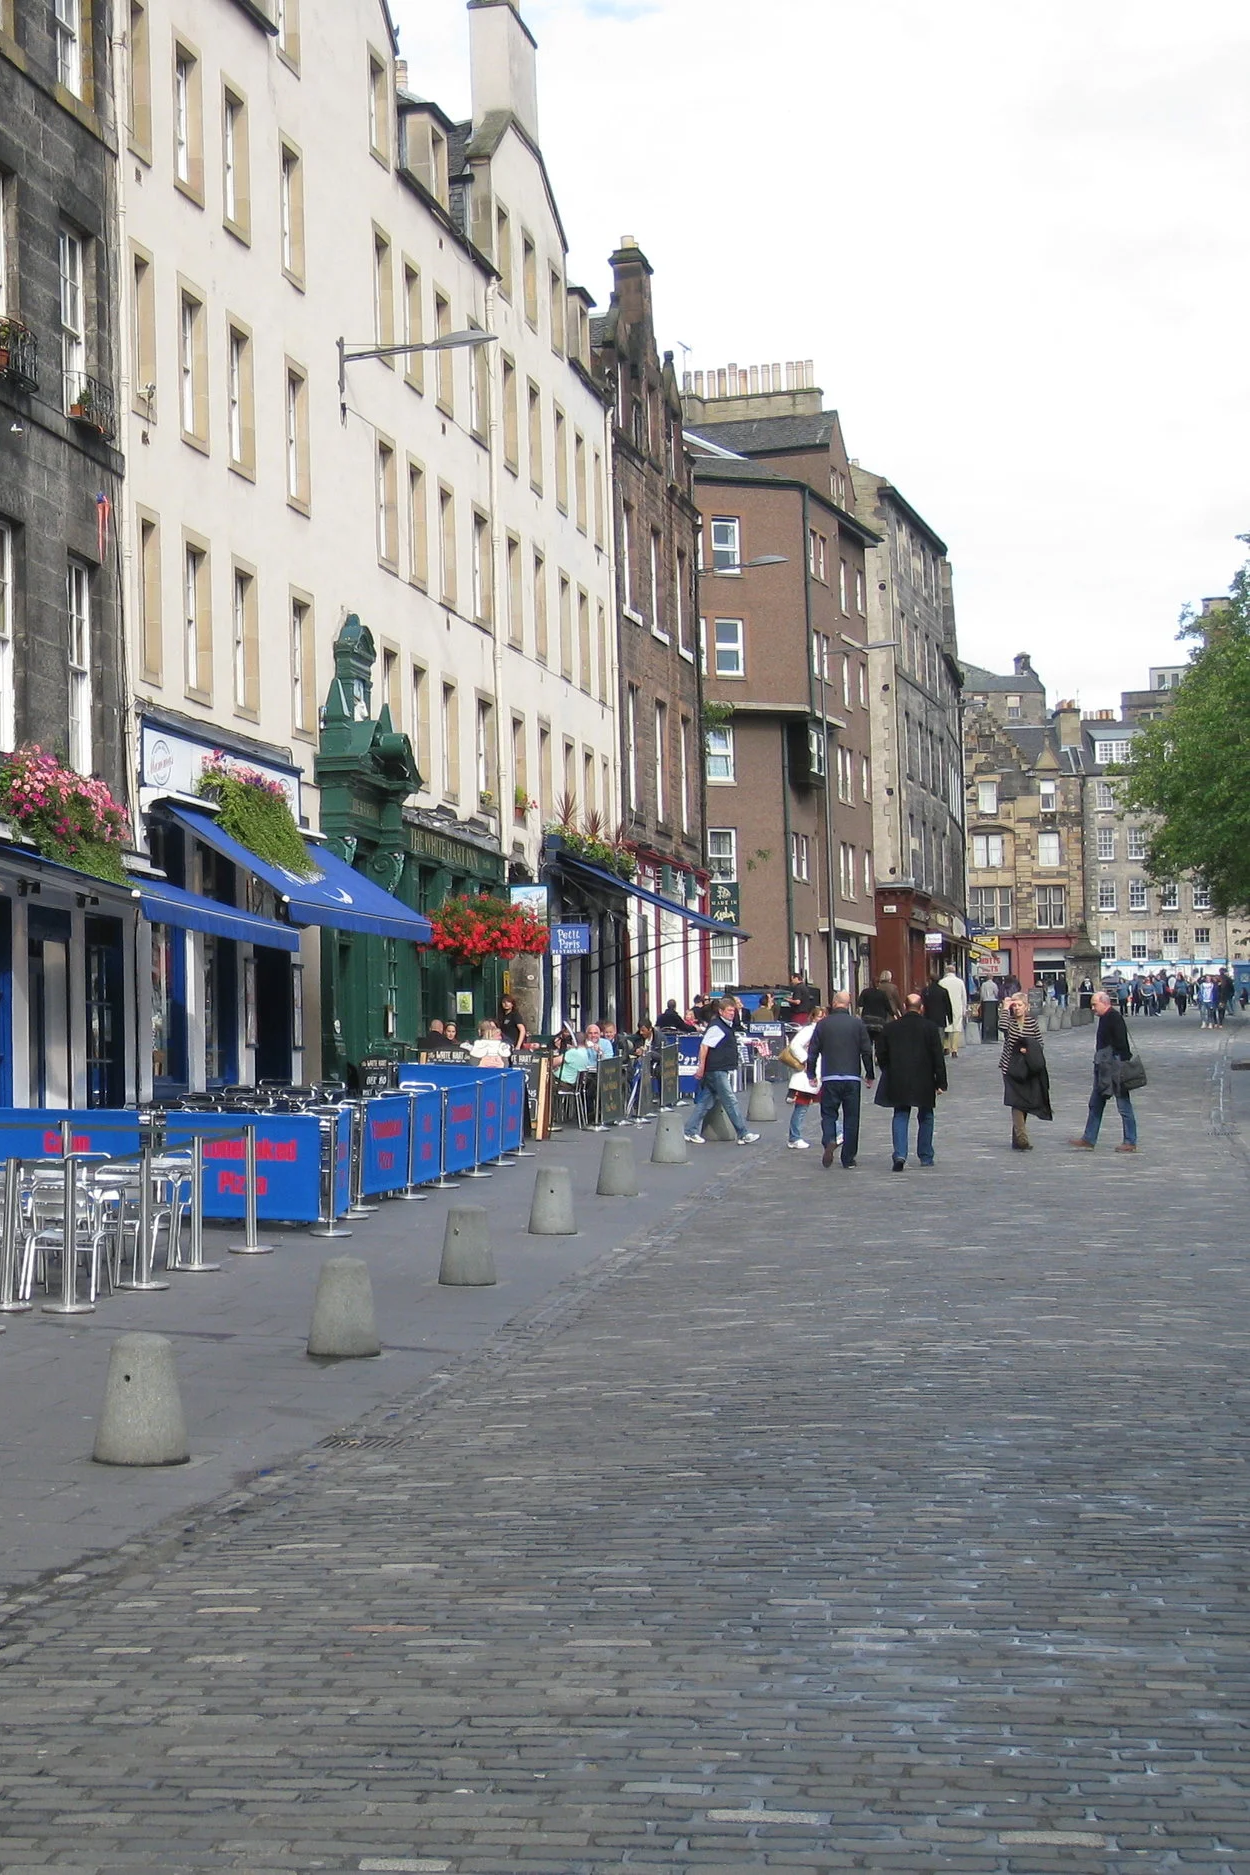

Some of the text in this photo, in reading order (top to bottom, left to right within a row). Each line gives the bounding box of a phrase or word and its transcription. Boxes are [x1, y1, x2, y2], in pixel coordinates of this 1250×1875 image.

[410, 828, 478, 870] THE WHITE HART INN
[556, 928, 581, 940] Petit
[558, 939, 581, 949] Paris
[452, 1051, 465, 1060] HART
[218, 1171, 268, 1196] Piza
